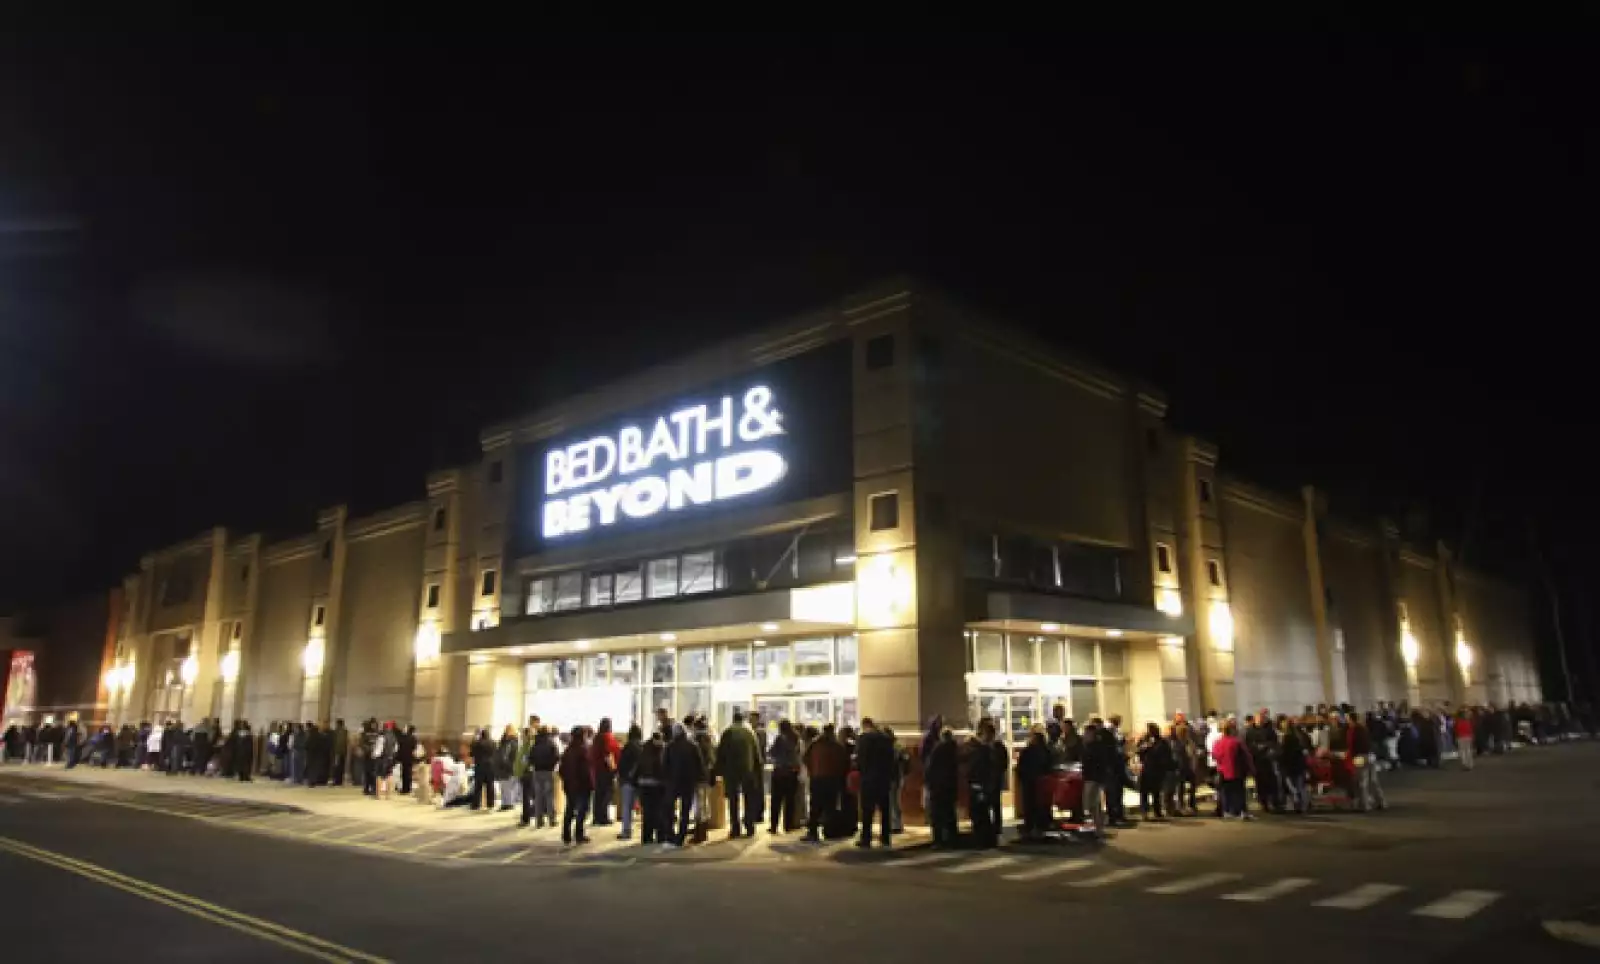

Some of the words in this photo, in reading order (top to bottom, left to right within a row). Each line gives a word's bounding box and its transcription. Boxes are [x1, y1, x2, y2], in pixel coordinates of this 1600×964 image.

[546, 436, 615, 494] BED
[619, 396, 733, 474] BATH
[739, 385, 787, 441] &
[543, 450, 788, 538] BEYOND
